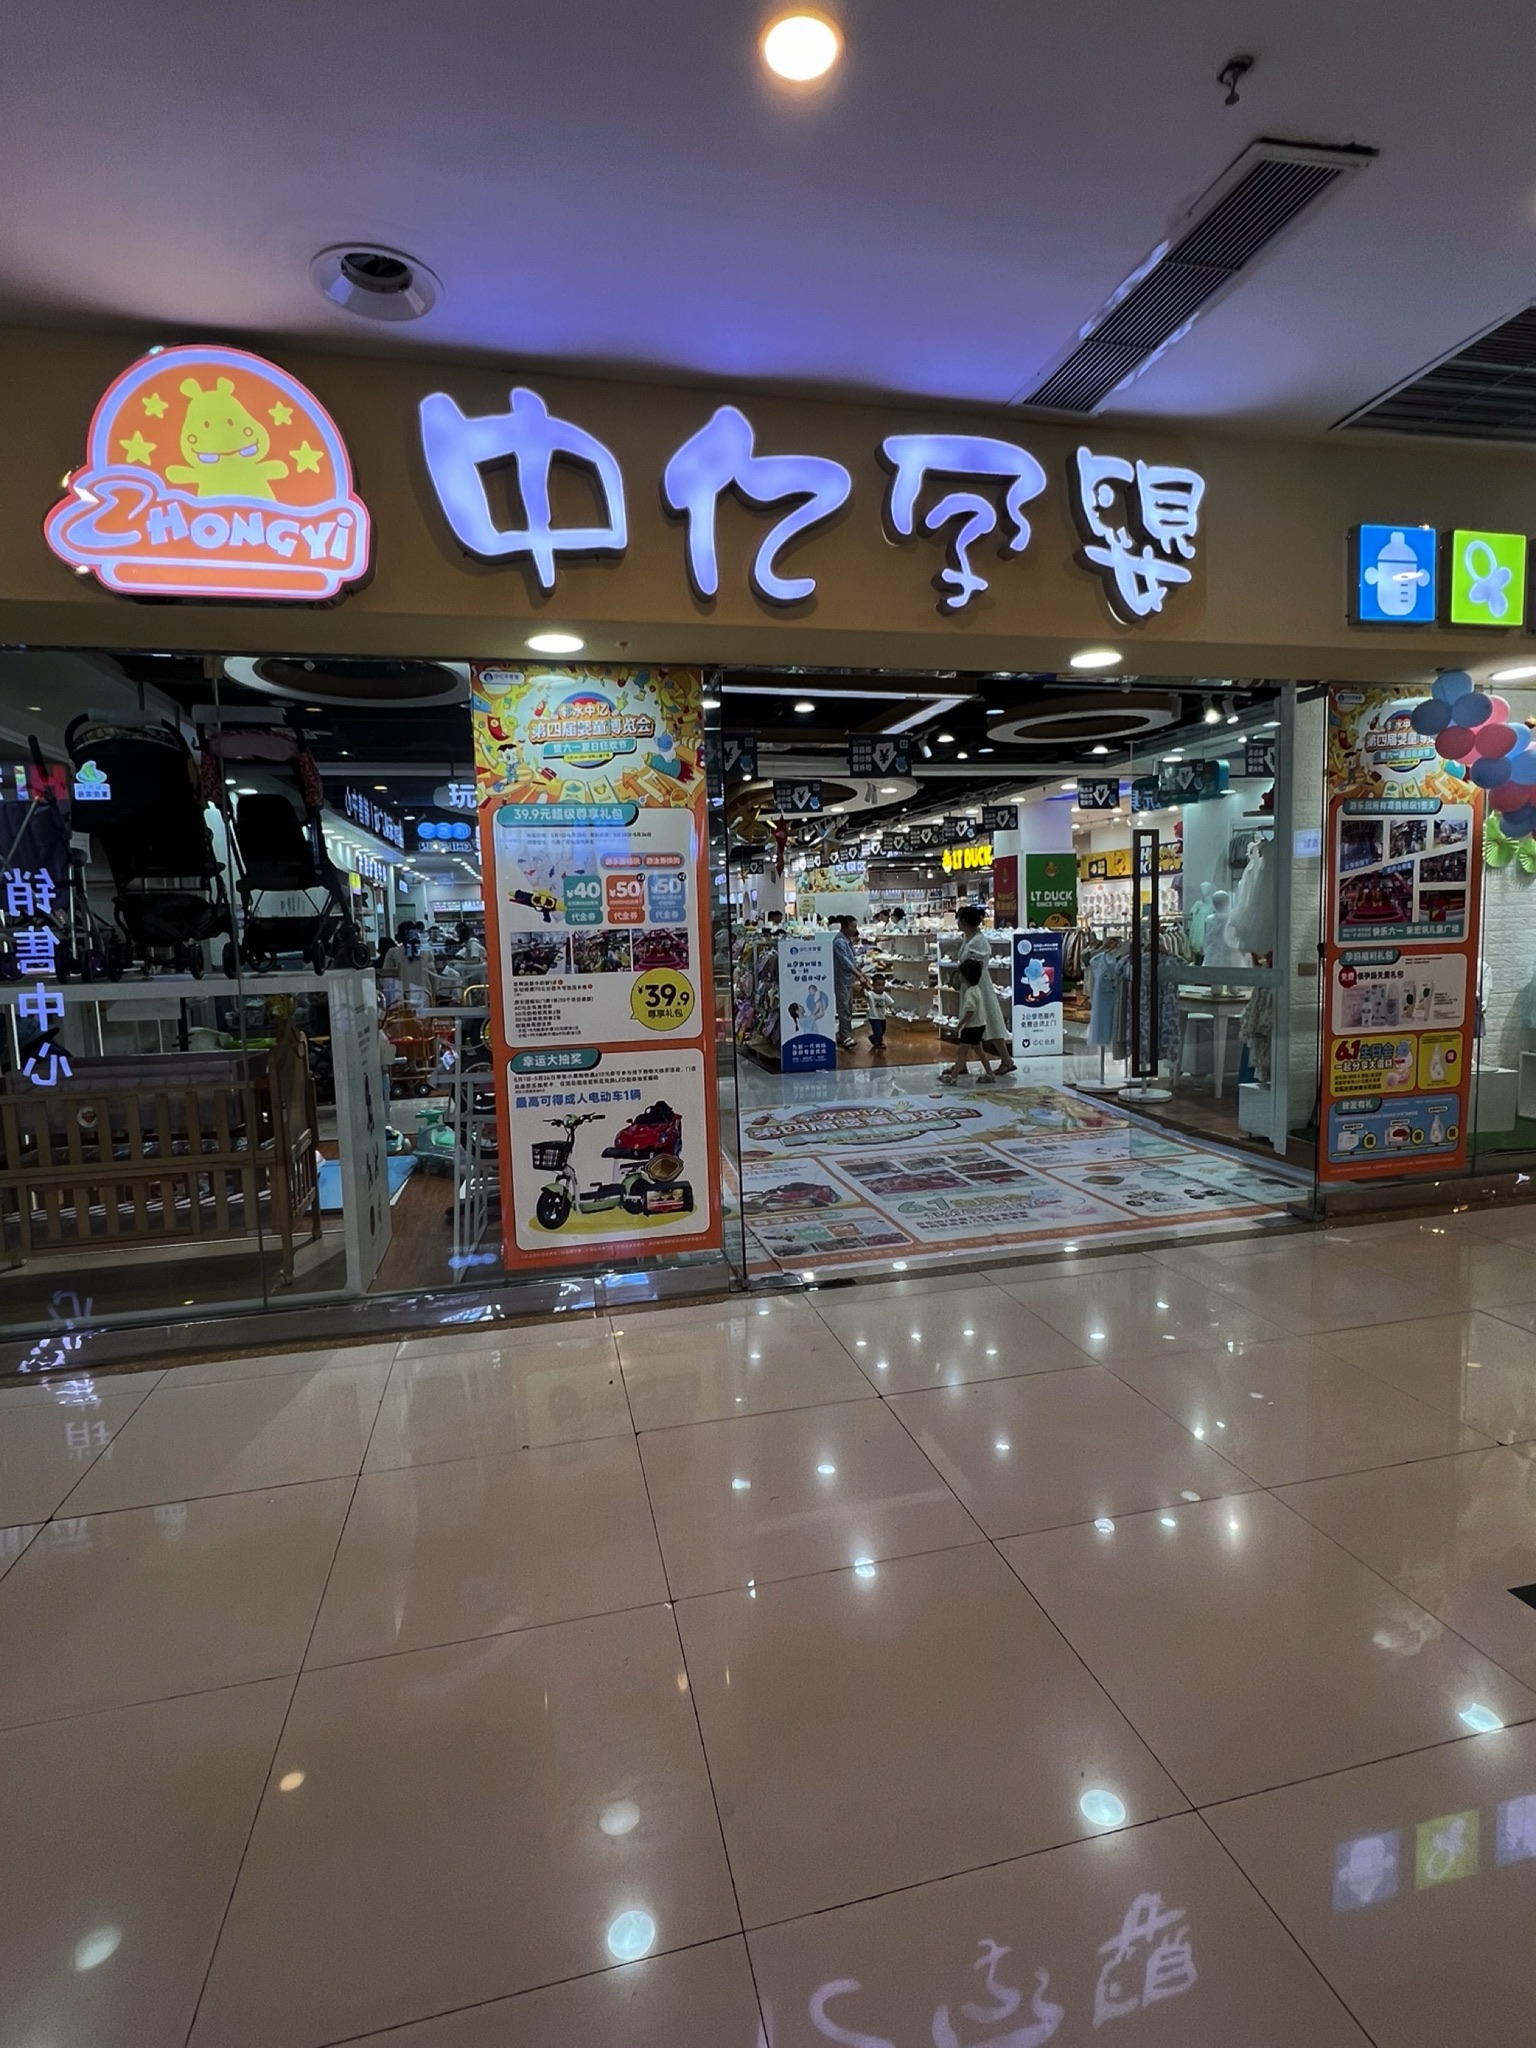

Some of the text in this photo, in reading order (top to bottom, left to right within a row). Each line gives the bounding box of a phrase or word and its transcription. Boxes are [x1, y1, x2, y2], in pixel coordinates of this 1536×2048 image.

[531, 719, 654, 739] 第四届婴童博览会
[513, 807, 625, 822] 39.9元超级尊享礼包
[964, 844, 993, 868] DUCK
[1030, 891, 1073, 901] LT DUCK
[571, 910, 596, 922] 代金券
[613, 909, 639, 921] 代金券
[655, 908, 679, 920] 代金券
[648, 1010, 684, 1019] 尊享礼包
[522, 1053, 583, 1068] 幸运大抽奖
[515, 1088, 642, 1109] 最高可得成人电动车1辆
